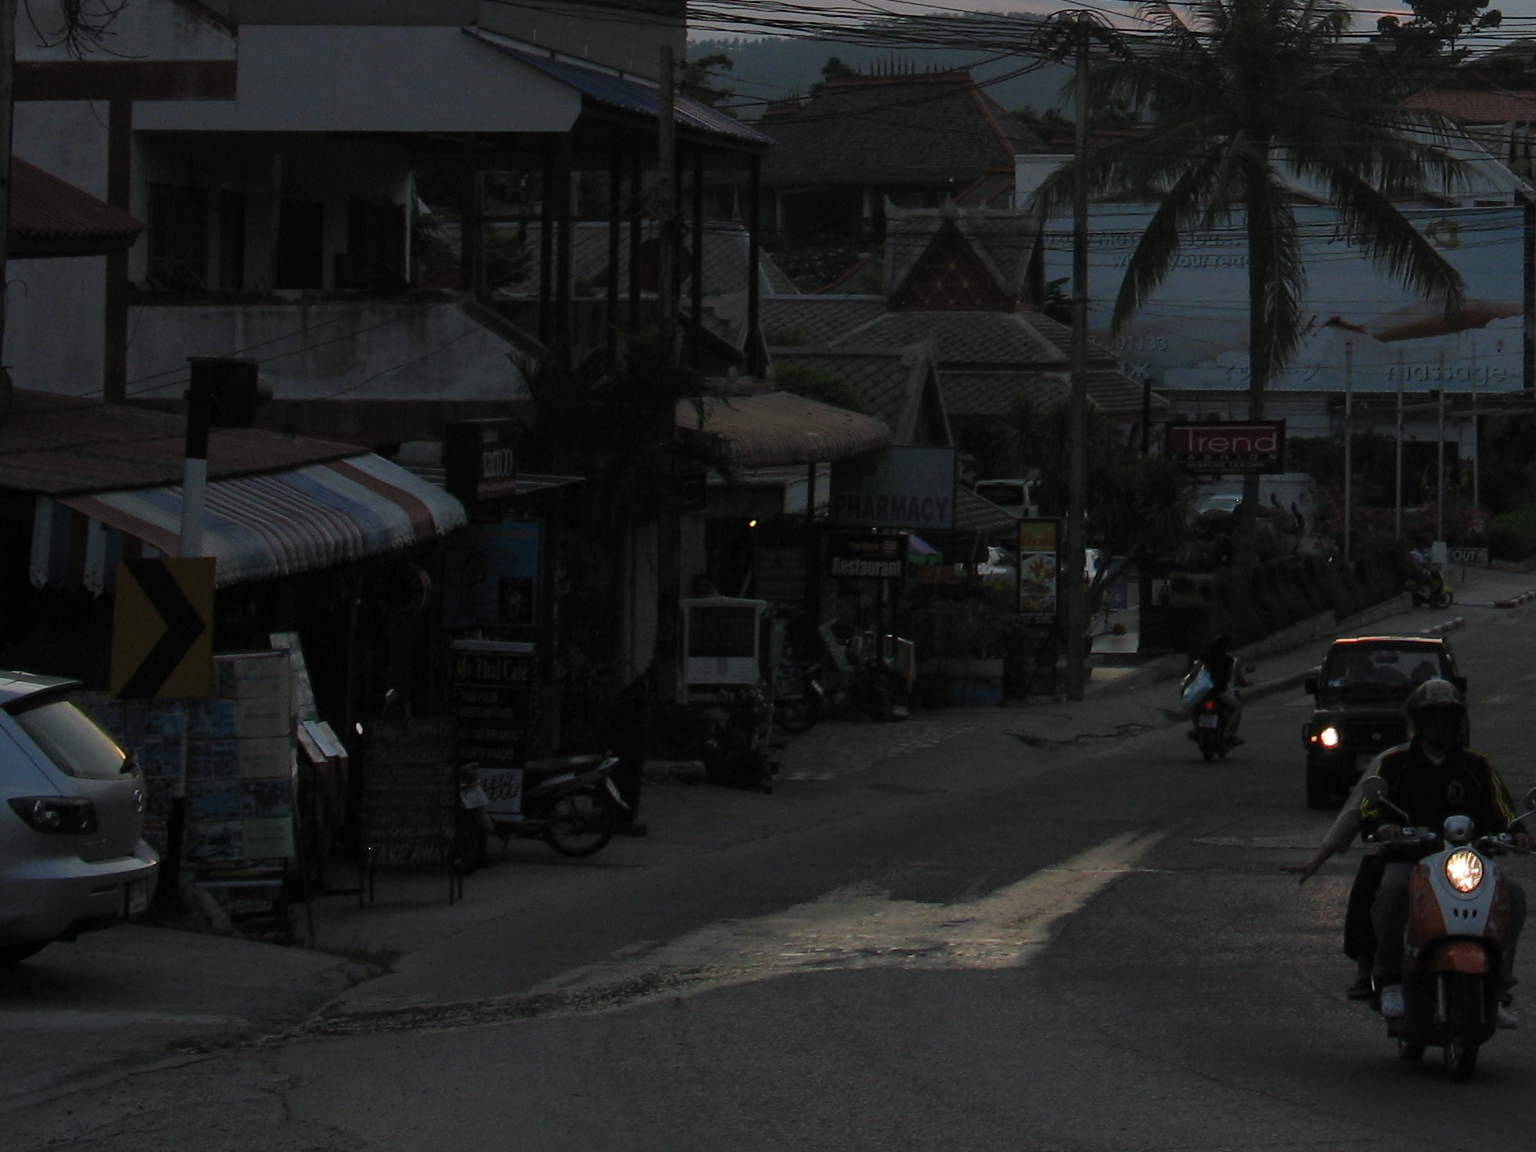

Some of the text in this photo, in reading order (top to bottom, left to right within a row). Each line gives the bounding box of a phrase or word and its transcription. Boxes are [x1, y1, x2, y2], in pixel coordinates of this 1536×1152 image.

[1172, 425, 1278, 454] Trend
[1171, 453, 1278, 461] FASHION
[833, 493, 949, 523] PHARMACY
[831, 555, 902, 578] Restaurant
[1452, 549, 1476, 562] OUT
[455, 657, 472, 681] My
[476, 657, 500, 680] Thai
[409, 841, 450, 865] AWAY
